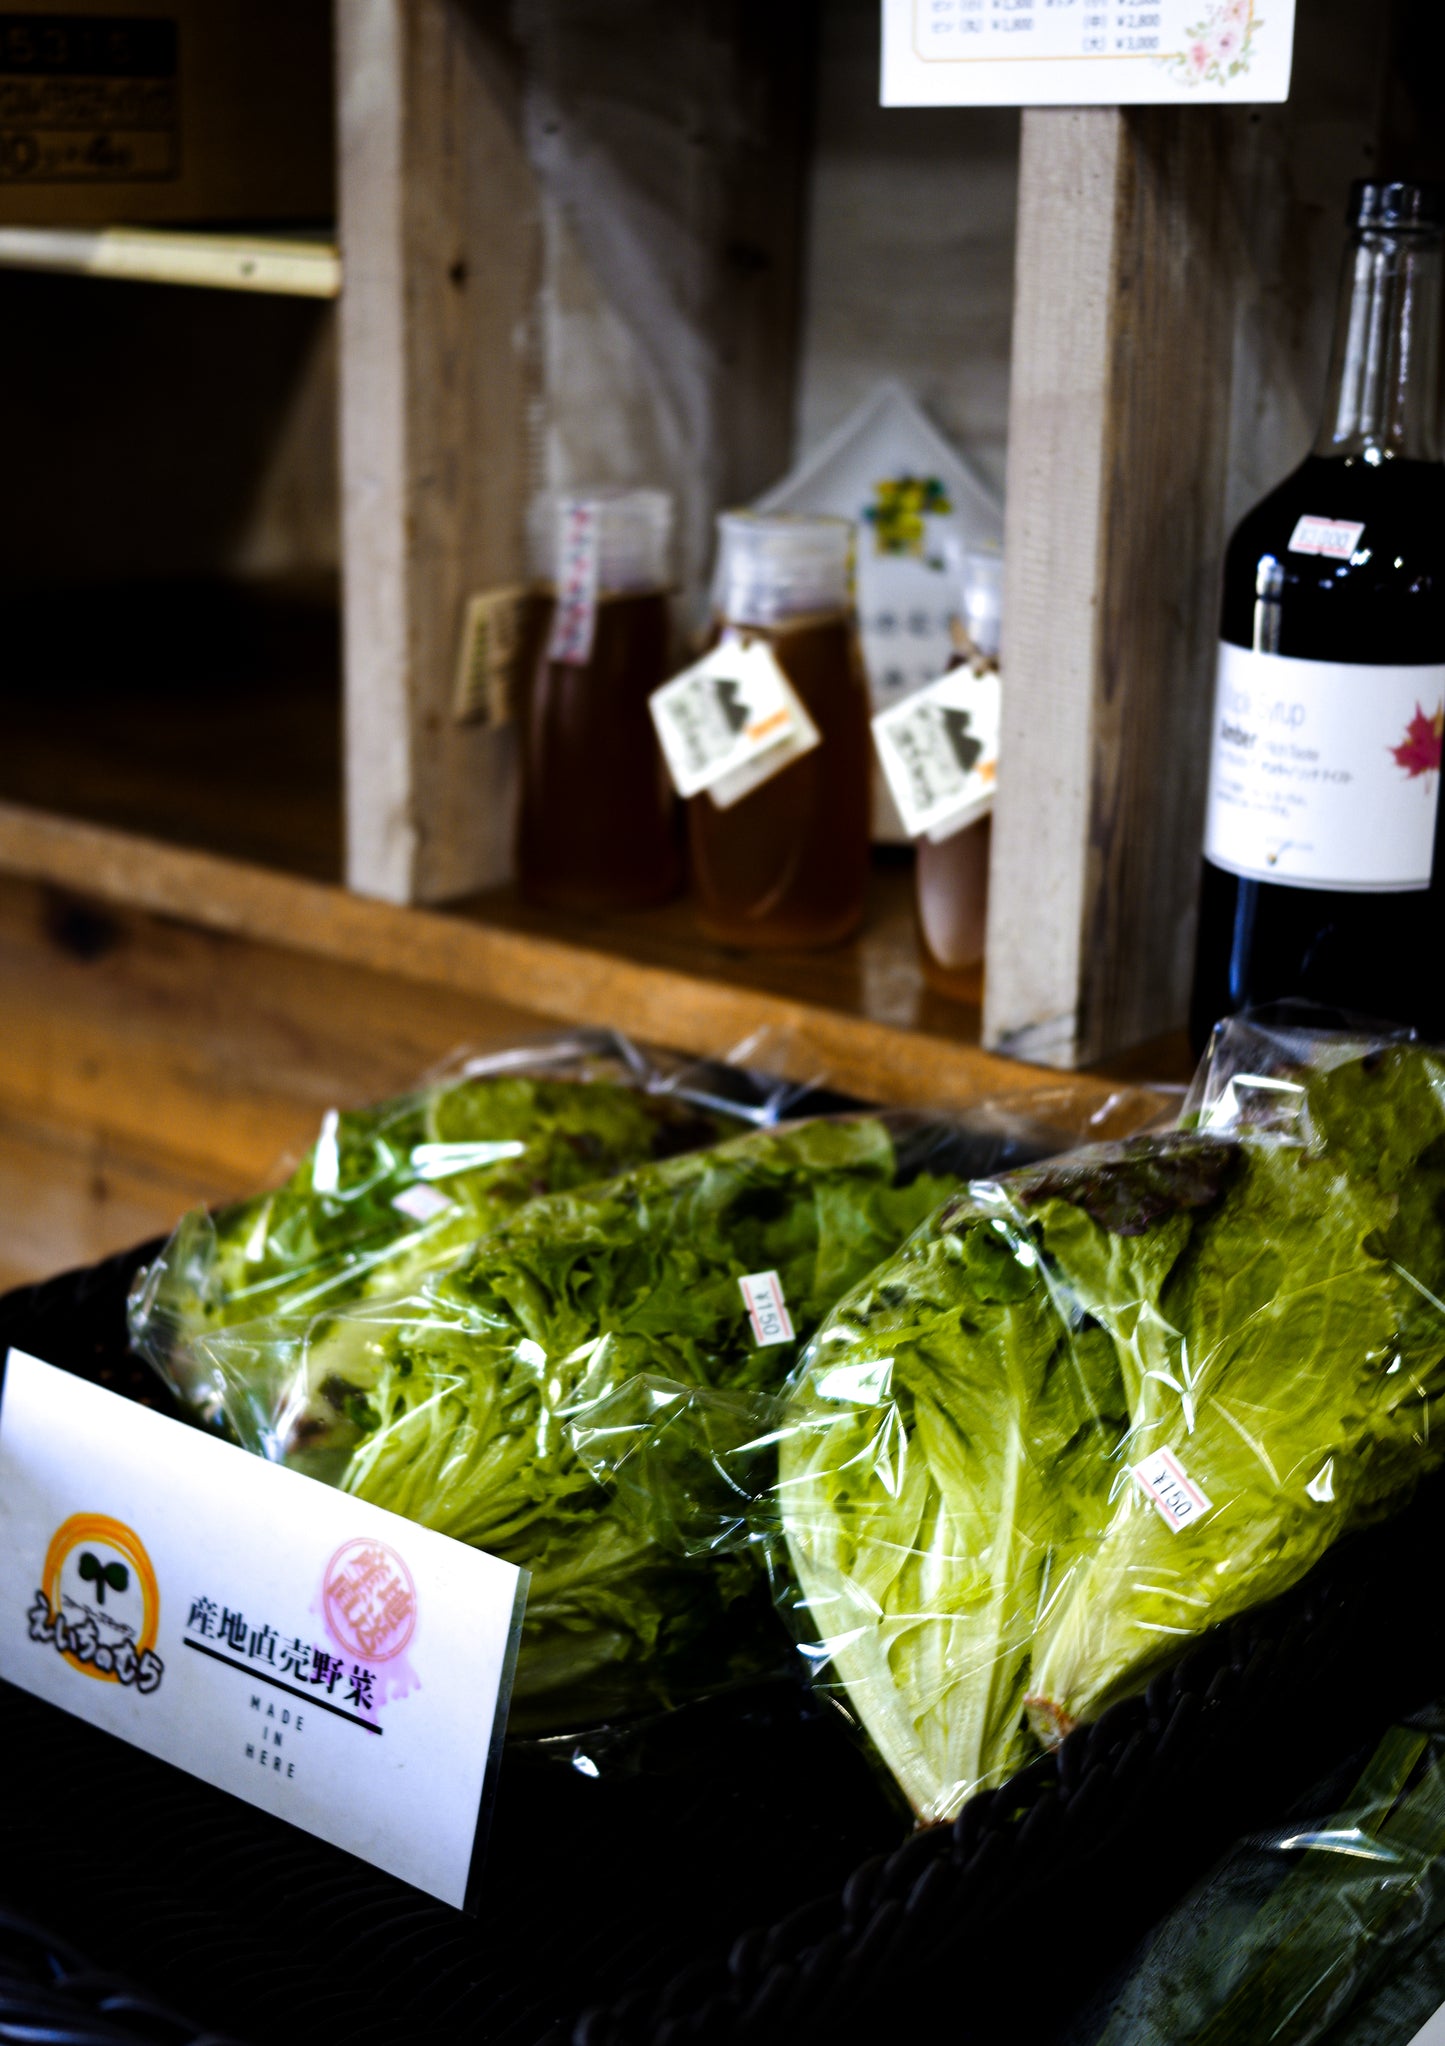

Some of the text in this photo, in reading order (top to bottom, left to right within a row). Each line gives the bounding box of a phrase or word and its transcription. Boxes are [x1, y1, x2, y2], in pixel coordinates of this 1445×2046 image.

[754, 1290, 780, 1336] ¥150
[1152, 1470, 1194, 1518] ¥150
[187, 1595, 377, 1710] 産地直売野菜
[250, 1694, 304, 1731] MADE
[262, 1726, 283, 1747] IN
[245, 1742, 295, 1779] HERE
